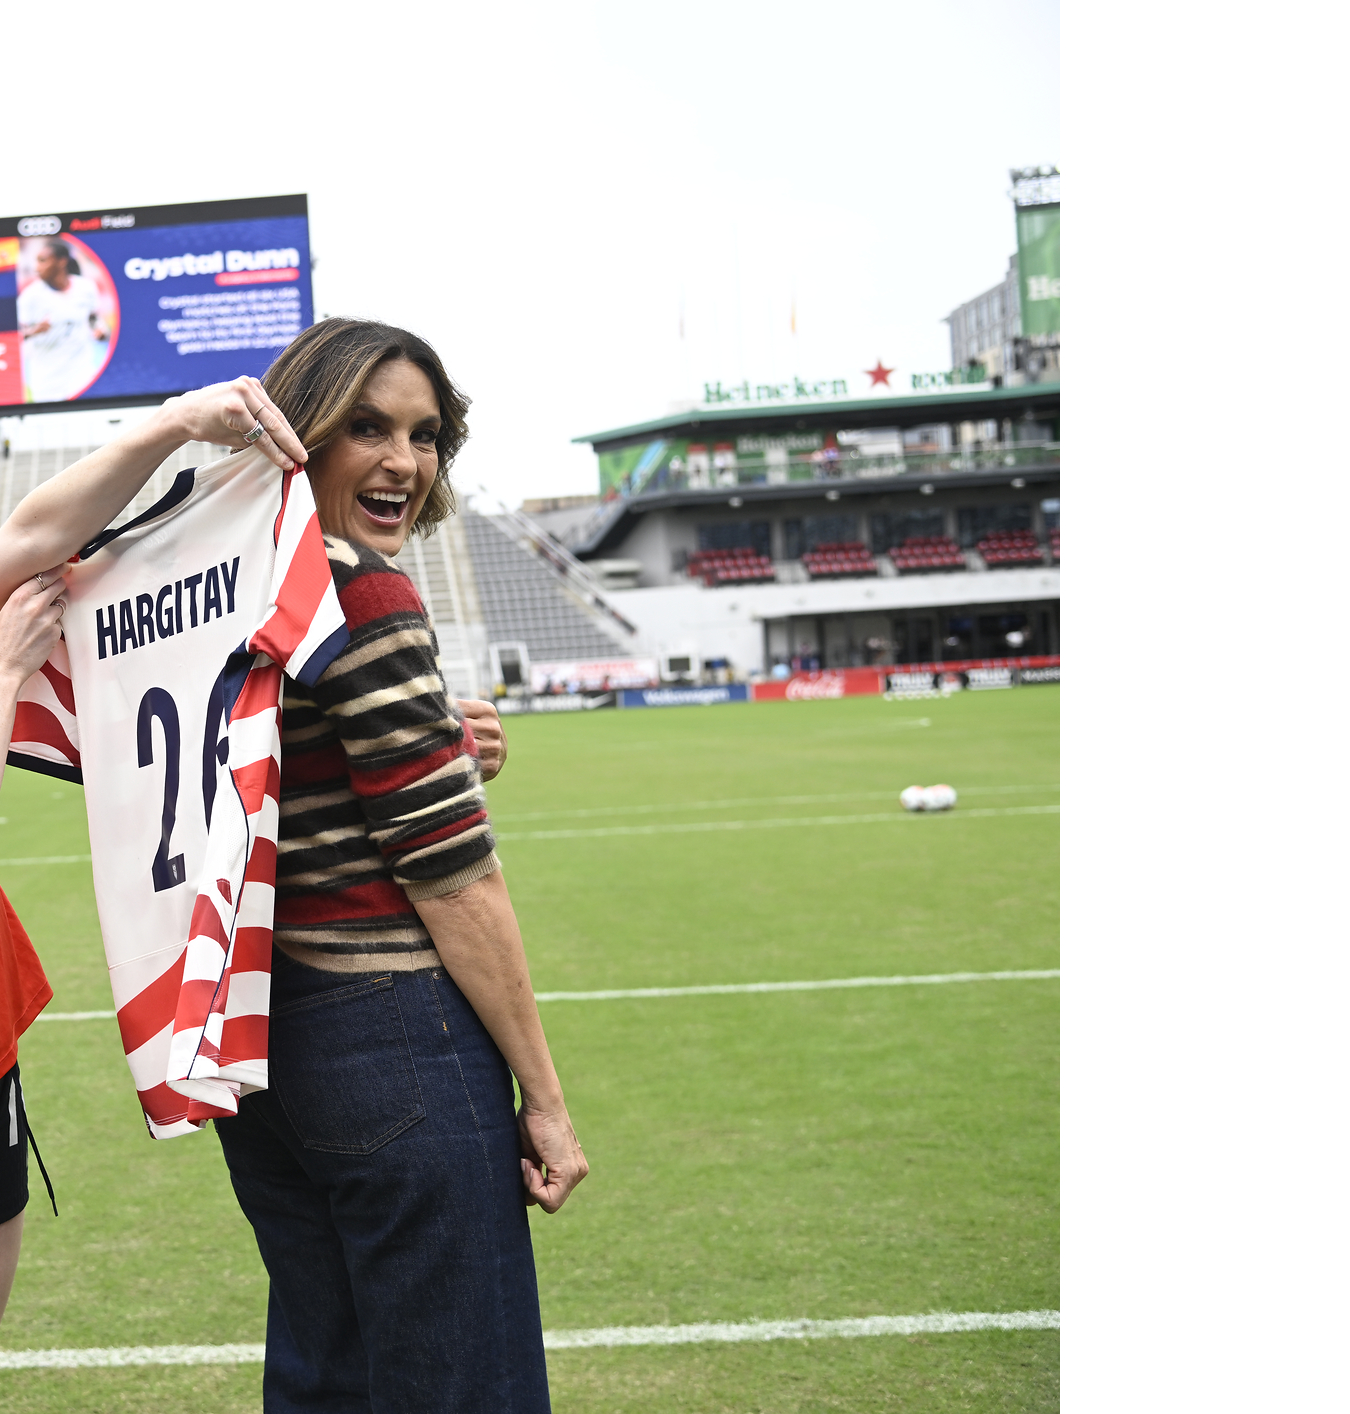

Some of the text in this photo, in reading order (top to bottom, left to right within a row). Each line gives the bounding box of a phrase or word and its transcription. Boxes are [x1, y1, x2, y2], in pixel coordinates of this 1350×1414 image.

[70, 214, 135, 232] Audi Field
[124, 250, 224, 281] Crystal
[225, 247, 300, 272] Dunn
[704, 375, 848, 403] Heineken
[95, 556, 240, 660] HARGITAY
[642, 687, 730, 705] Volkswagen
[785, 675, 845, 700] Coca-Cola
